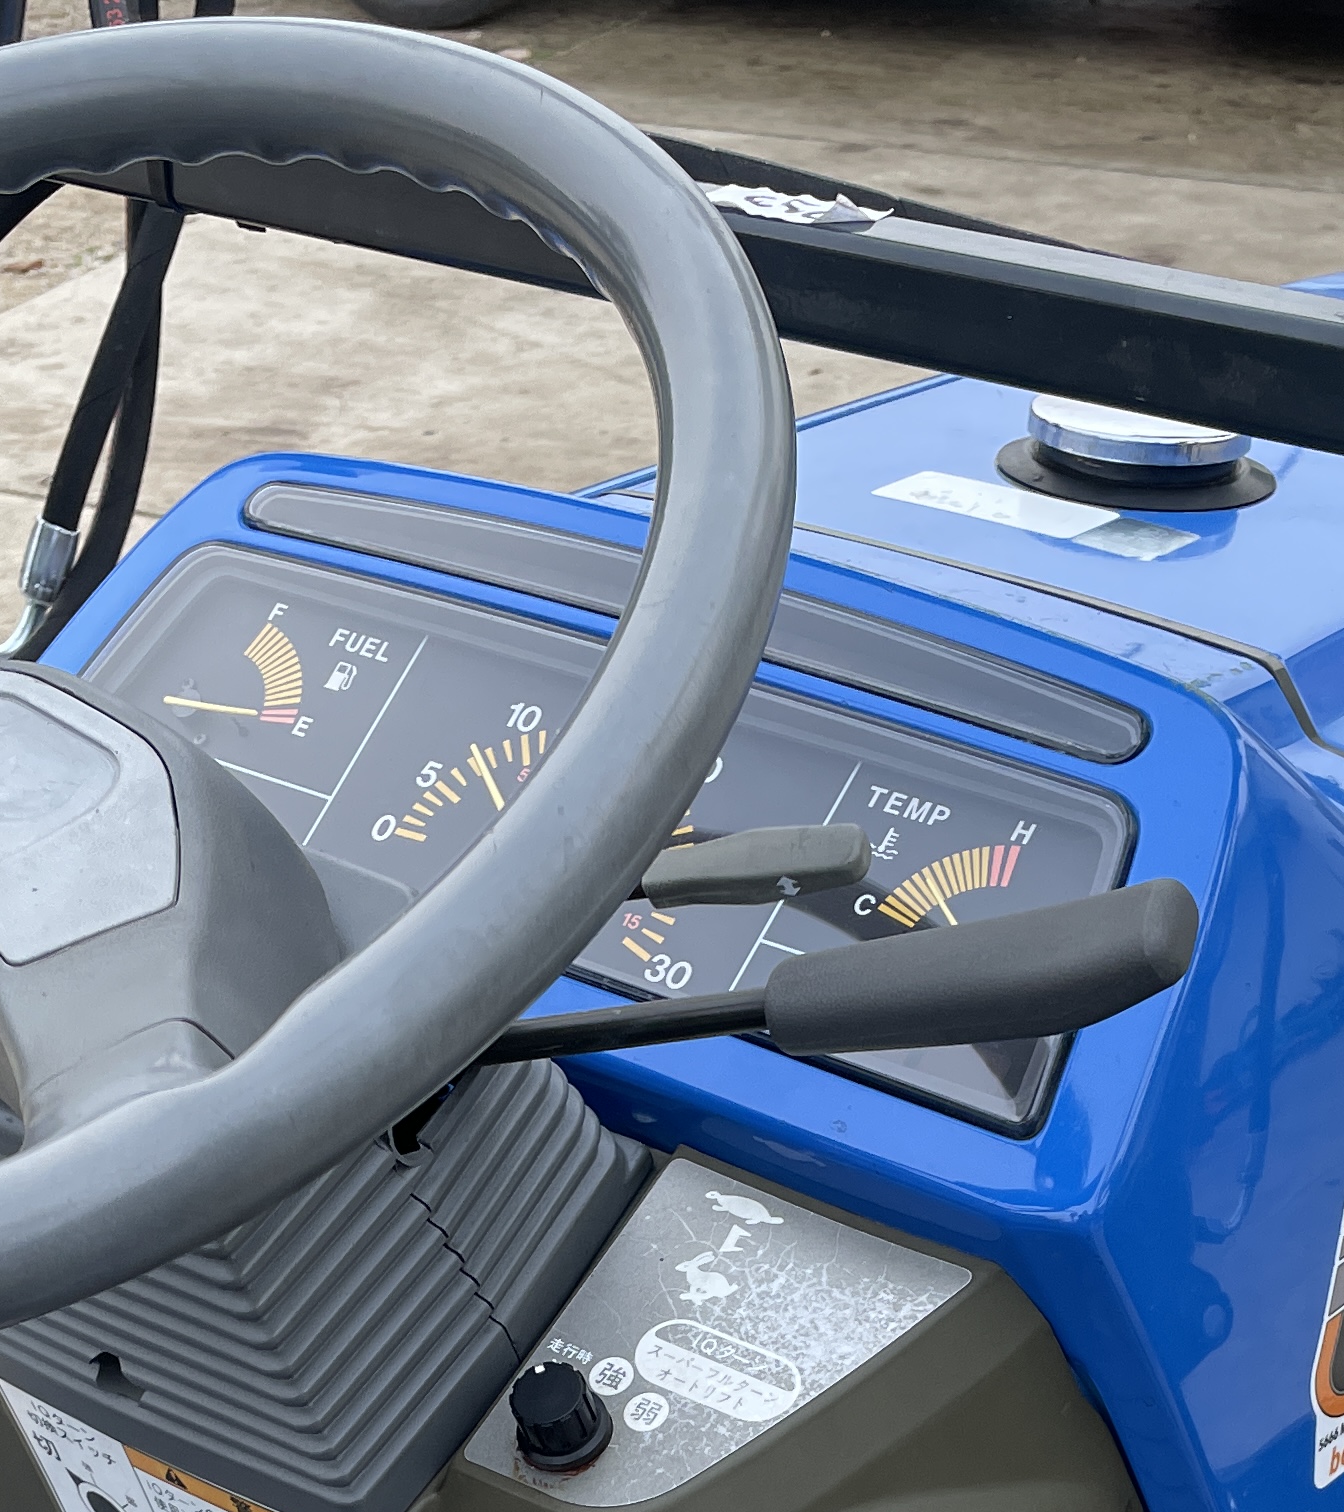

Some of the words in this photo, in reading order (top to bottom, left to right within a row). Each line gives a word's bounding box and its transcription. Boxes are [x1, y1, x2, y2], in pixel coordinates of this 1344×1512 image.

[268, 602, 289, 621] F
[328, 628, 389, 663] FUEL
[291, 715, 314, 737] E
[506, 702, 542, 732] 10
[416, 760, 443, 788] 5
[867, 784, 952, 827] TEMP
[371, 814, 397, 841] 0
[1010, 820, 1038, 844] H
[853, 894, 877, 916] C
[621, 912, 643, 931] 15
[644, 954, 693, 990] 30
[546, 1337, 594, 1365] 走行時
[595, 1362, 627, 1391] 強
[656, 1368, 744, 1411] オートリフト
[630, 1398, 664, 1426] 弱
